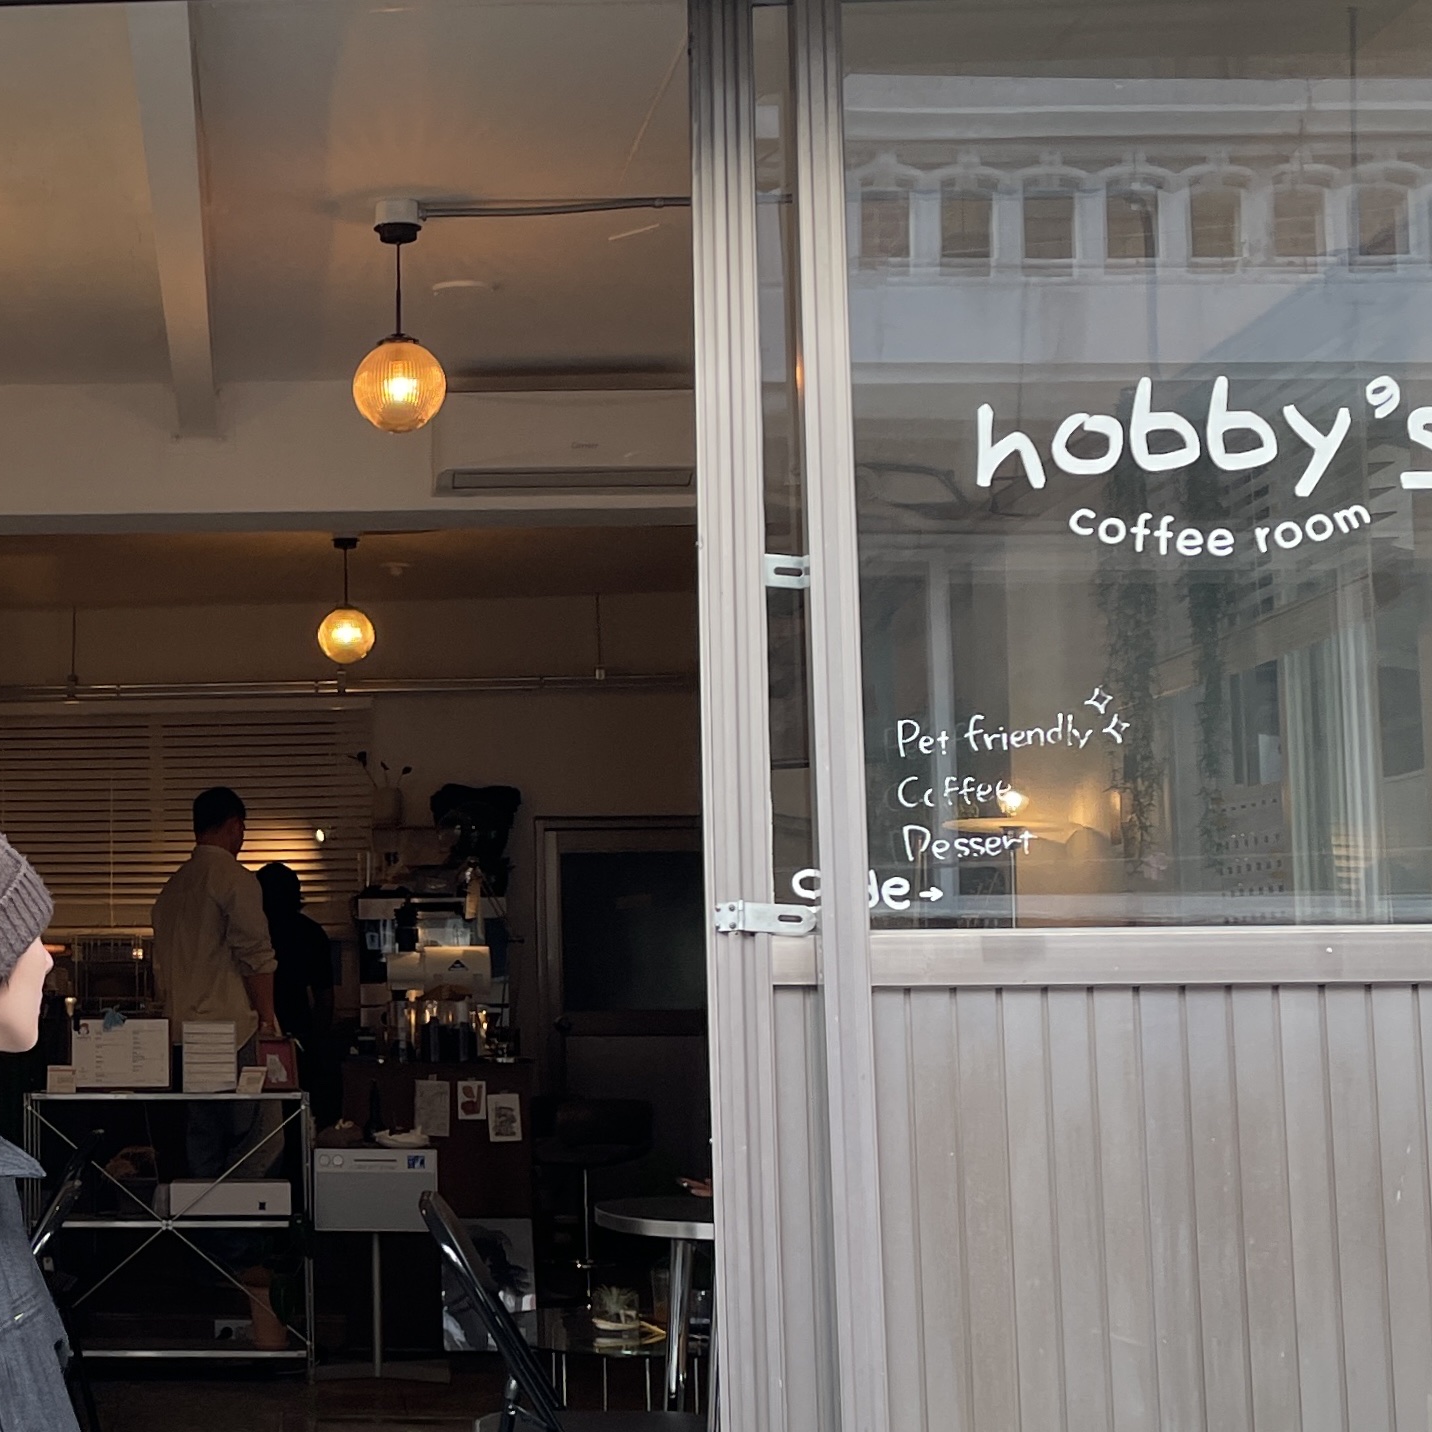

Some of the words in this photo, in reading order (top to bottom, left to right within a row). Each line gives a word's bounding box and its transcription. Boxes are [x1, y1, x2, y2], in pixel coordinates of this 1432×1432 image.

[976, 375, 1432, 497] hobby's
[1069, 507, 1236, 556] coffee
[1254, 503, 1371, 553] room
[896, 719, 949, 757] Pet
[964, 713, 1093, 751] friendly
[902, 824, 1035, 861] Dessert
